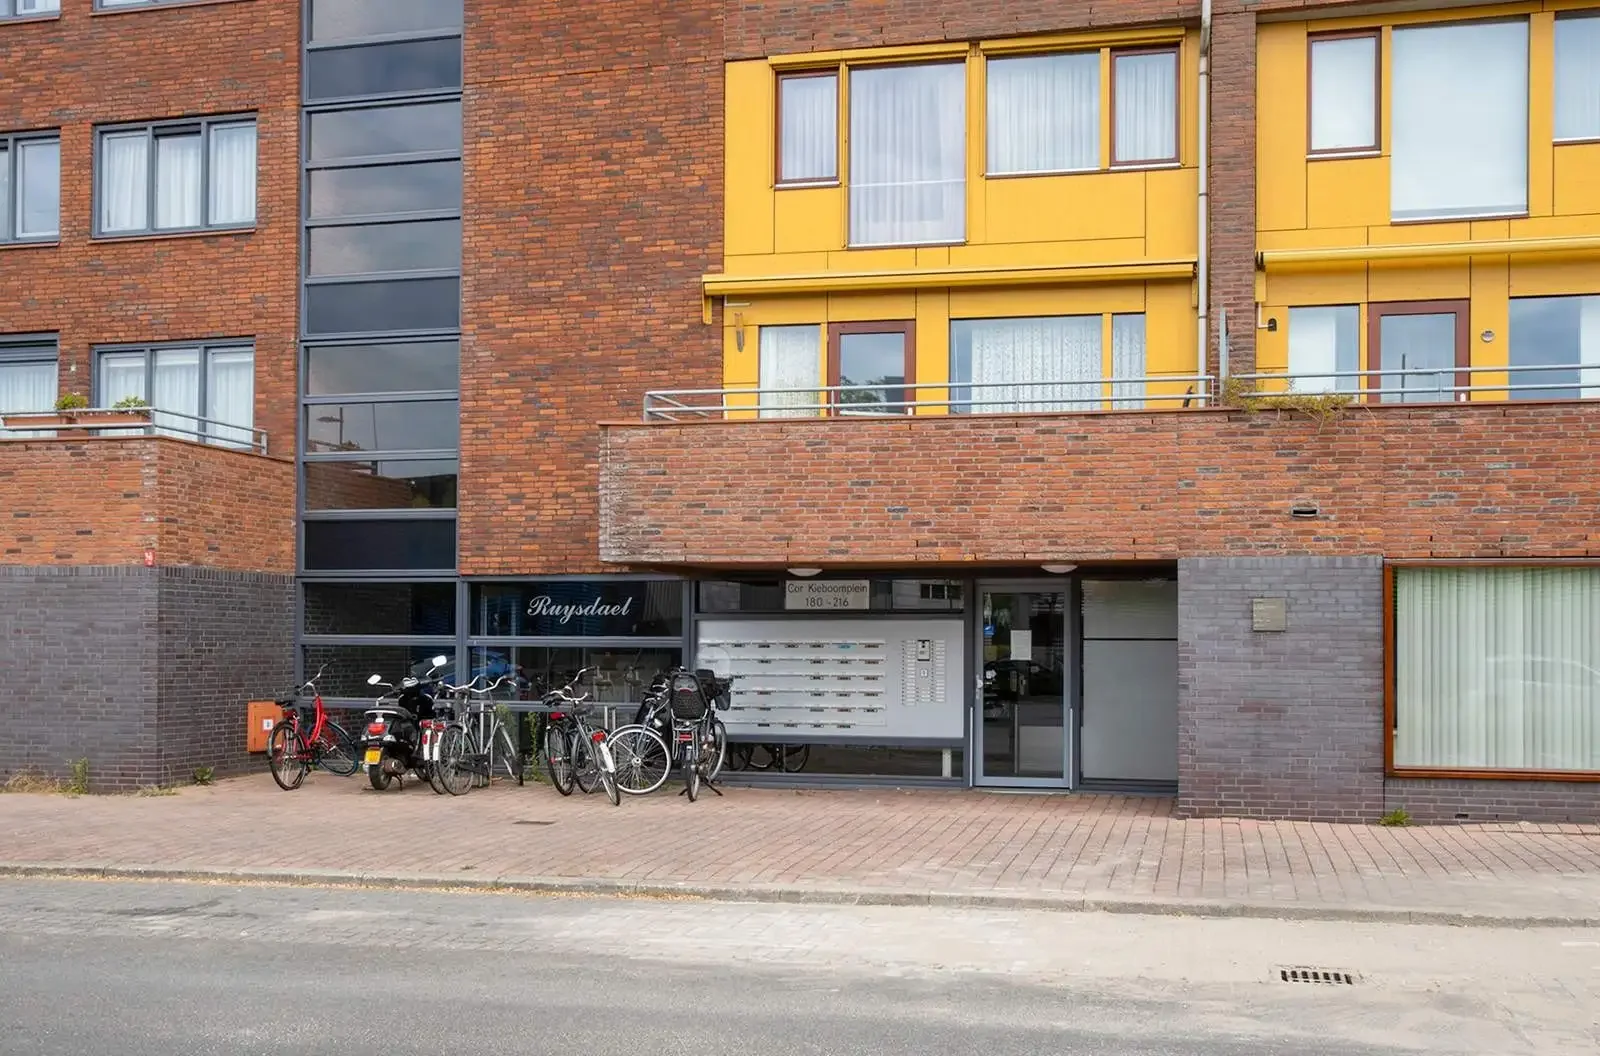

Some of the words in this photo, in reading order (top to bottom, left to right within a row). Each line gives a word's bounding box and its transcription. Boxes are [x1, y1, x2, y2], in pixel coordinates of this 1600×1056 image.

[787, 583, 804, 594] Cor
[808, 583, 868, 595] Kieboomplein
[527, 595, 633, 625] Ruysdael
